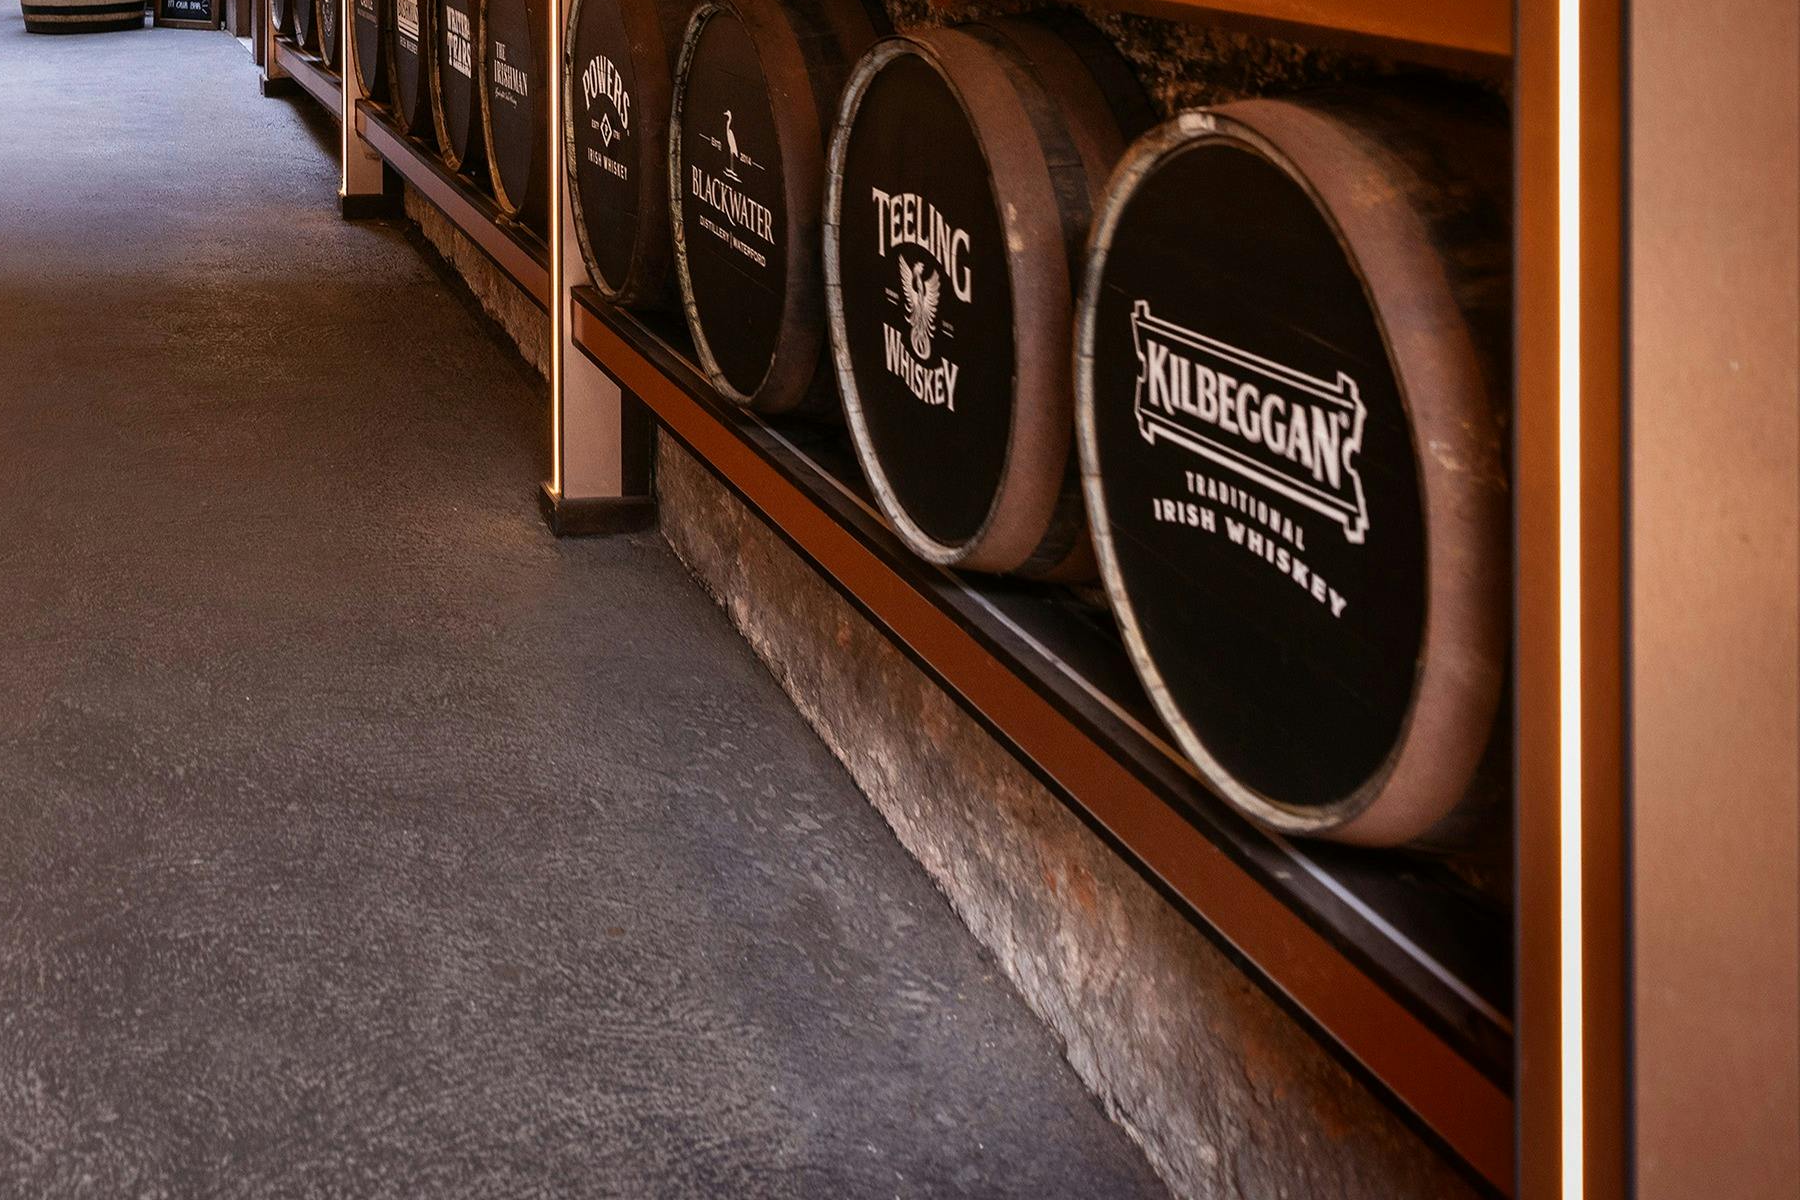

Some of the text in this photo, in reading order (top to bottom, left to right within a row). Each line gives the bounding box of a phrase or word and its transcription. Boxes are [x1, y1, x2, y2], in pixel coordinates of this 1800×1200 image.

[582, 54, 630, 130] POWERS
[692, 164, 776, 246] BLACKWATER
[871, 185, 973, 304] TEELING
[883, 322, 960, 413] WHISKEY
[1146, 338, 1342, 490] KILBEGGAN
[1185, 471, 1306, 553] TRADITIONAL
[1153, 497, 1348, 621] IRISH WHISKEY
